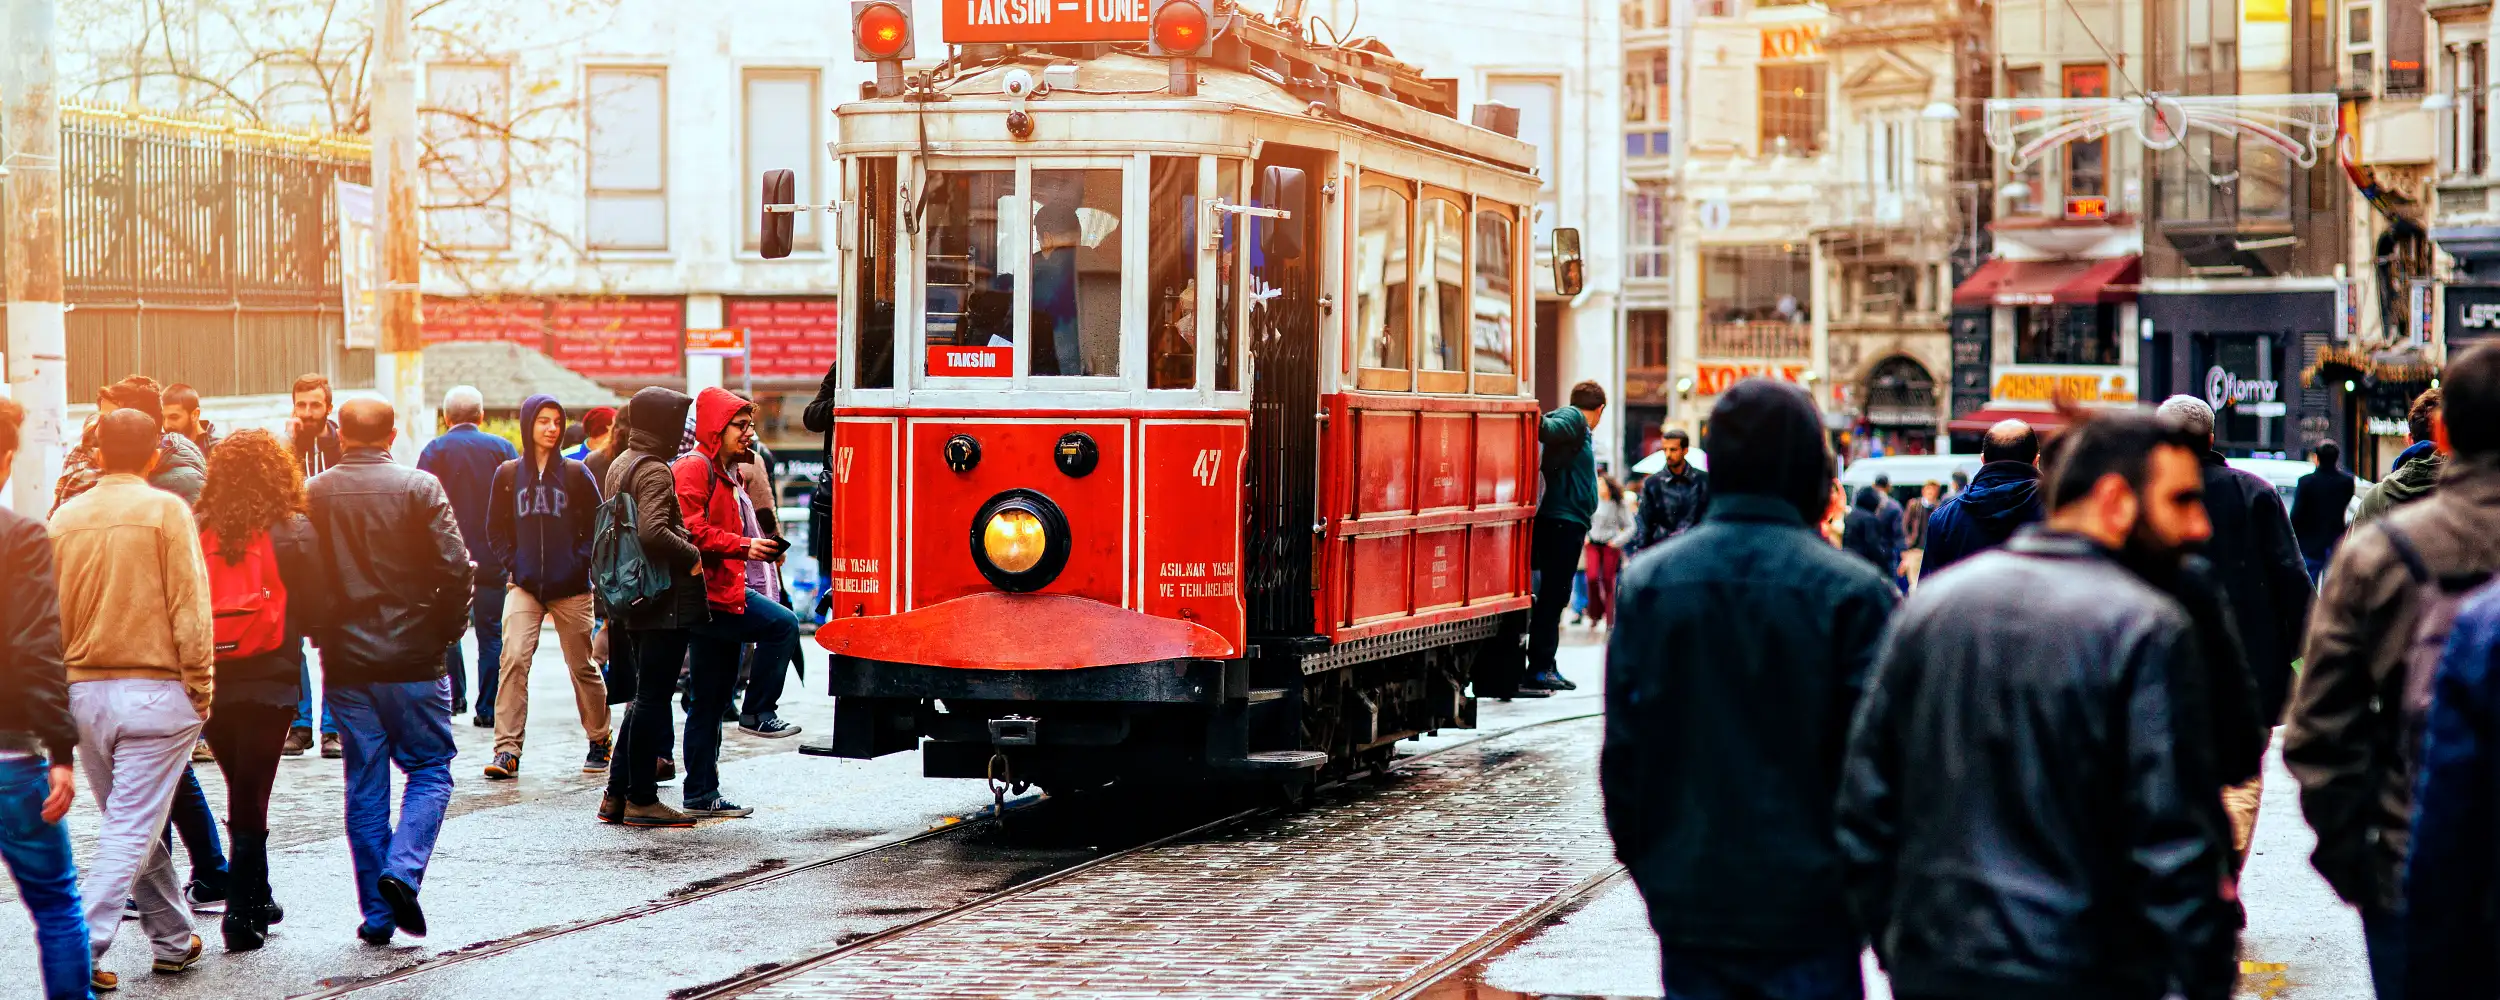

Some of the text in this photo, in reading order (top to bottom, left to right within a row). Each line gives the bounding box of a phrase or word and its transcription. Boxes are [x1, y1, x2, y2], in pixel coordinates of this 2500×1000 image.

[946, 350, 996, 368] TAKSİM
[837, 446, 854, 483] 47
[1193, 449, 1222, 486] 47
[517, 485, 568, 518] GAP
[850, 558, 879, 573] YASAK
[1160, 583, 1175, 598] VE
